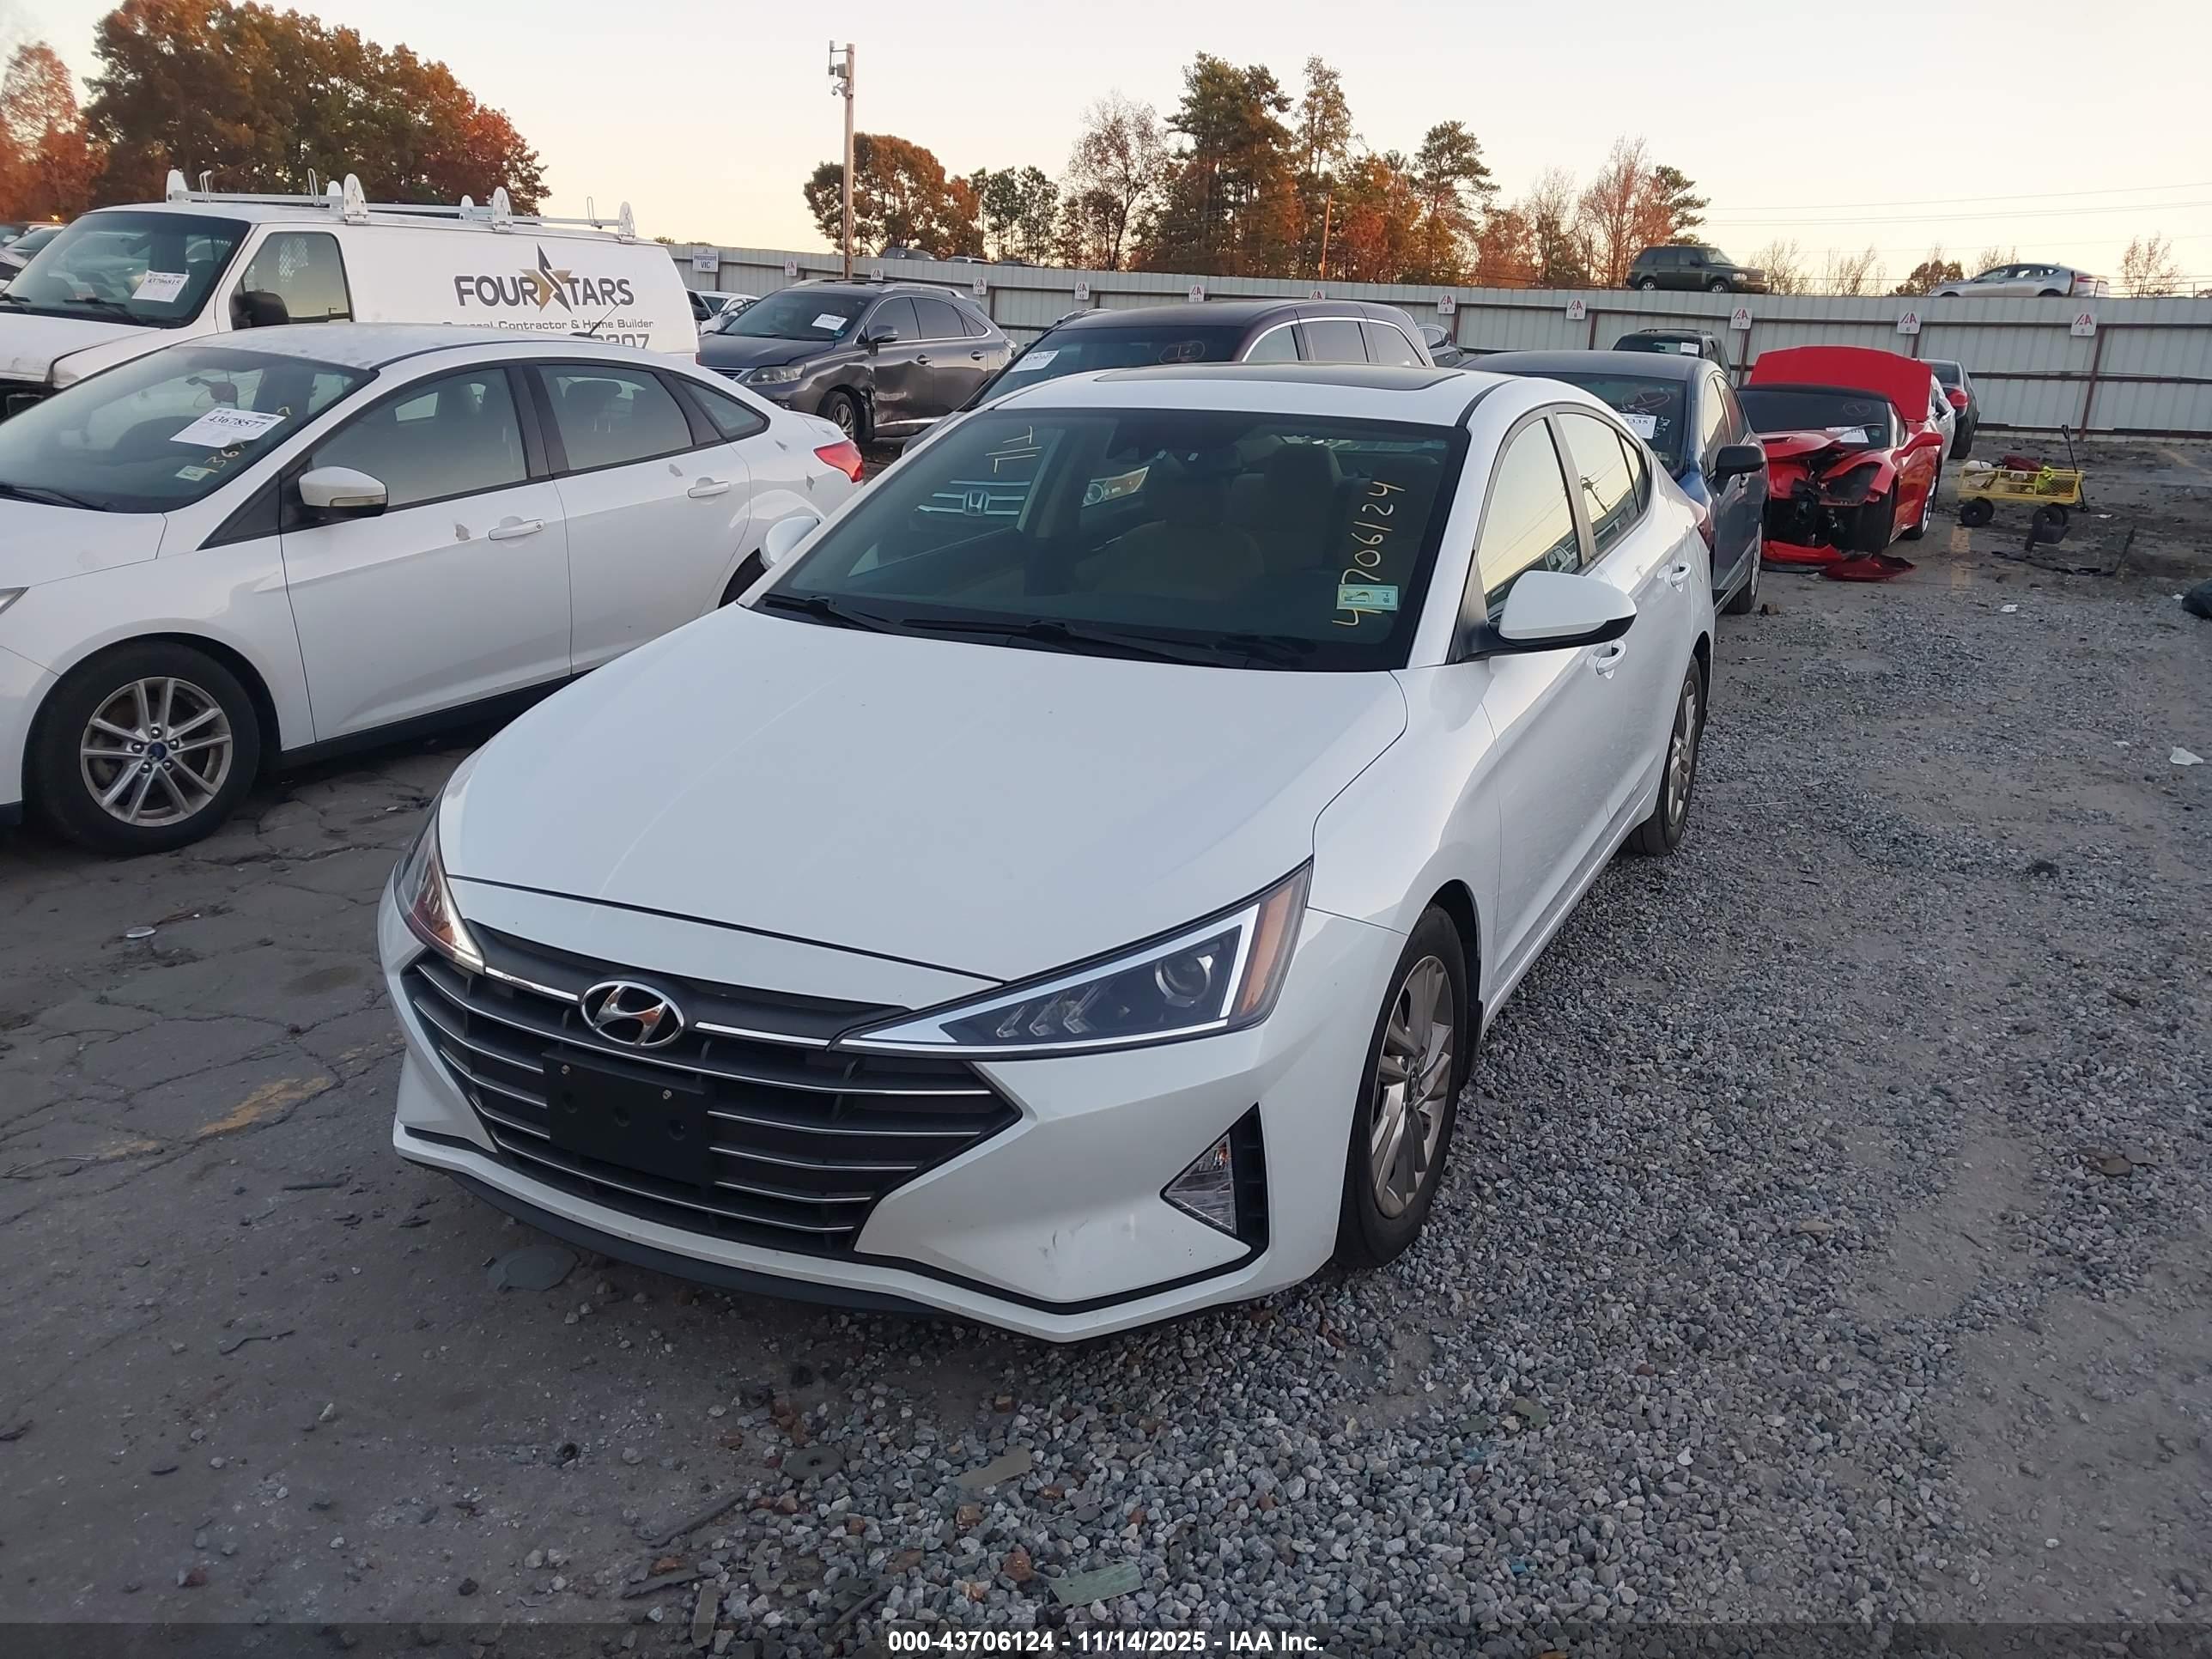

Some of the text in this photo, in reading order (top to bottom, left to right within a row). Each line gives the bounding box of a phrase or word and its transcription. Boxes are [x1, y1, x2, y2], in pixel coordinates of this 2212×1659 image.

[700, 260, 711, 269] VIC
[453, 275, 539, 307] FOUR
[498, 320, 567, 331] Contractor
[570, 319, 580, 329] &
[583, 319, 614, 329] Home
[617, 319, 653, 329] Builder
[207, 416, 267, 428] 43678577
[1332, 481, 1407, 627] 4706124
